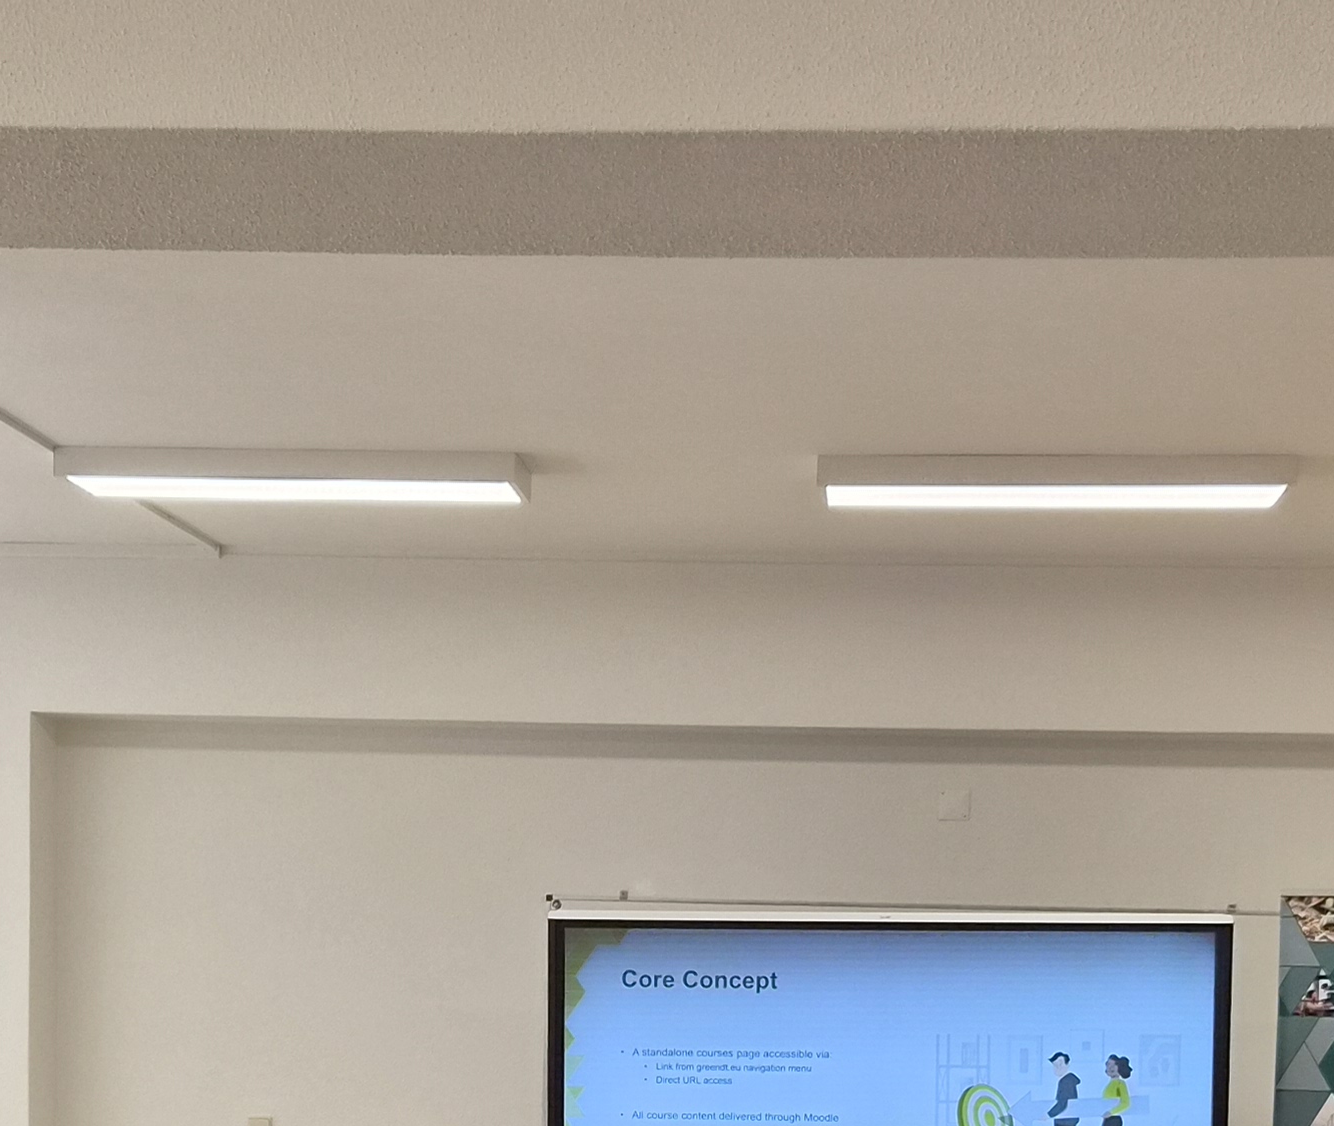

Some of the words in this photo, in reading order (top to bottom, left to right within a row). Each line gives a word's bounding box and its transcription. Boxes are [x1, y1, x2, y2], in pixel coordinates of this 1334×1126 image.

[622, 969, 675, 988] Core
[682, 970, 778, 994] Concept
[632, 1049, 640, 1057] A
[642, 1048, 694, 1057] standalone
[696, 1050, 733, 1058] courses
[736, 1051, 760, 1060] page
[763, 1050, 813, 1059] accessible
[655, 1062, 673, 1071] Link
[675, 1063, 694, 1071] from
[743, 1064, 786, 1074] navigation
[788, 1065, 812, 1073] menu
[655, 1076, 680, 1084] Direct
[682, 1076, 701, 1085] URL
[703, 1077, 733, 1085] access
[632, 1111, 644, 1119] All
[646, 1112, 679, 1120] course
[681, 1112, 716, 1121] content
[719, 1112, 762, 1121] delivered
[764, 1113, 801, 1123] through
[803, 1113, 839, 1122] Moodle
